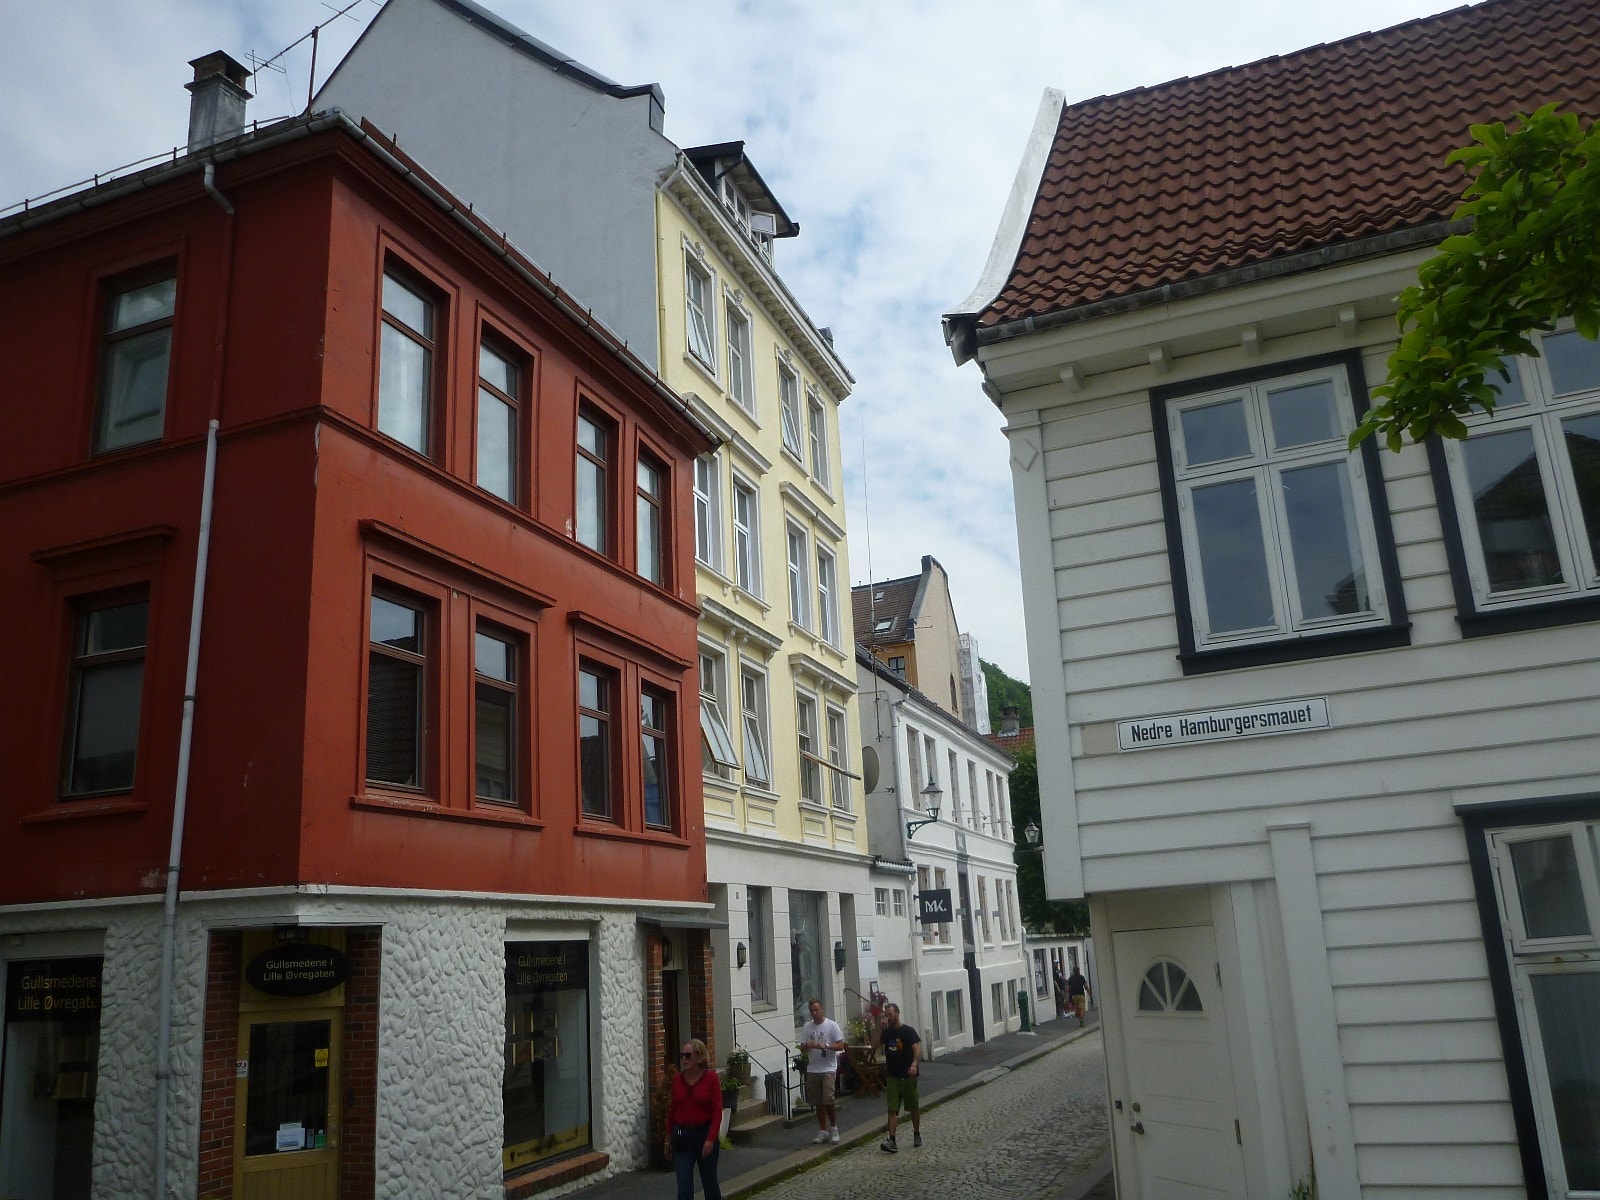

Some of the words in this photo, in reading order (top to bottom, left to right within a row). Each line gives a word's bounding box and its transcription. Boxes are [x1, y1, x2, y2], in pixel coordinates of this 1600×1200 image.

[1131, 723, 1173, 743] Nedre
[1179, 704, 1312, 735] Hamburgersmauet
[265, 959, 328, 970] Gullsmedene
[21, 973, 97, 990] Gullsmedene
[263, 971, 283, 982] Lille
[285, 969, 335, 981] Øvregaten
[18, 995, 41, 1010] Lille
